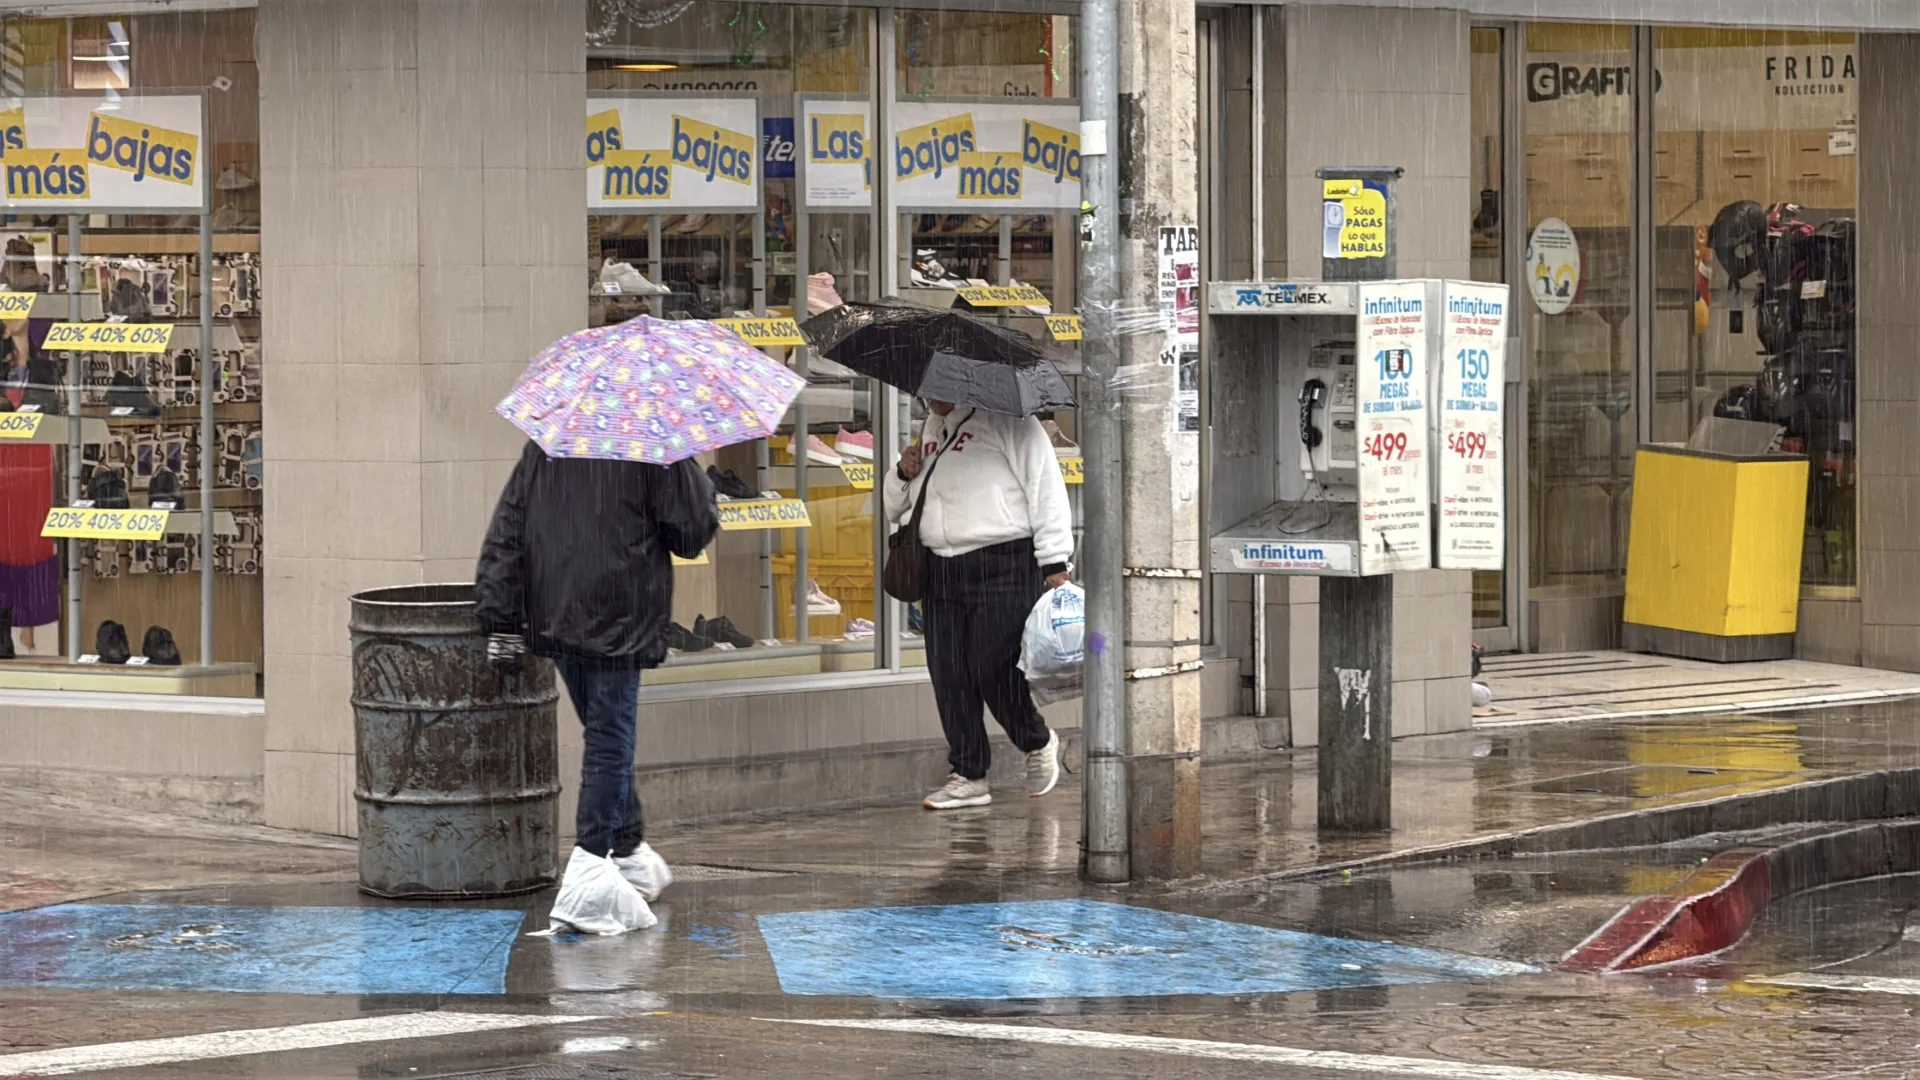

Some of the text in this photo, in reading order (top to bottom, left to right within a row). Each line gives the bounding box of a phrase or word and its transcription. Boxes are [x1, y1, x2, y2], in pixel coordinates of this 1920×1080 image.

[1766, 54, 1855, 80] FRIDA
[1775, 84, 1844, 95] KOLLECTION
[812, 118, 863, 159] Las
[88, 117, 192, 182] bajas
[672, 118, 751, 182] bajas
[895, 128, 974, 180] bajas
[8, 152, 86, 195] más
[604, 153, 669, 195] más
[960, 156, 1020, 195] más
[1353, 205, 1375, 216] SÓLO
[1346, 218, 1383, 228] PAGAS
[1360, 233, 1376, 242] QUE
[1341, 243, 1383, 252] HABLAS
[1265, 292, 1328, 304] TELMEX
[1365, 296, 1422, 315] infinitum
[1449, 294, 1502, 316] infinitum
[49, 326, 169, 344] 20% 40% 60%
[741, 323, 770, 337] 40%
[771, 322, 799, 337] 60%
[1049, 319, 1076, 333] 20%
[1374, 348, 1413, 380] 10
[1456, 348, 1490, 380] 150
[1380, 382, 1409, 399] MEGAS
[1461, 382, 1487, 398] MEGAS
[0, 416, 39, 430] 60%
[1363, 432, 1407, 461] $499
[1448, 431, 1486, 458] $499
[46, 512, 164, 531] 20% 40% 60%
[748, 505, 776, 521] 40%
[778, 504, 806, 520] 60%
[1244, 544, 1324, 559] infinitum
